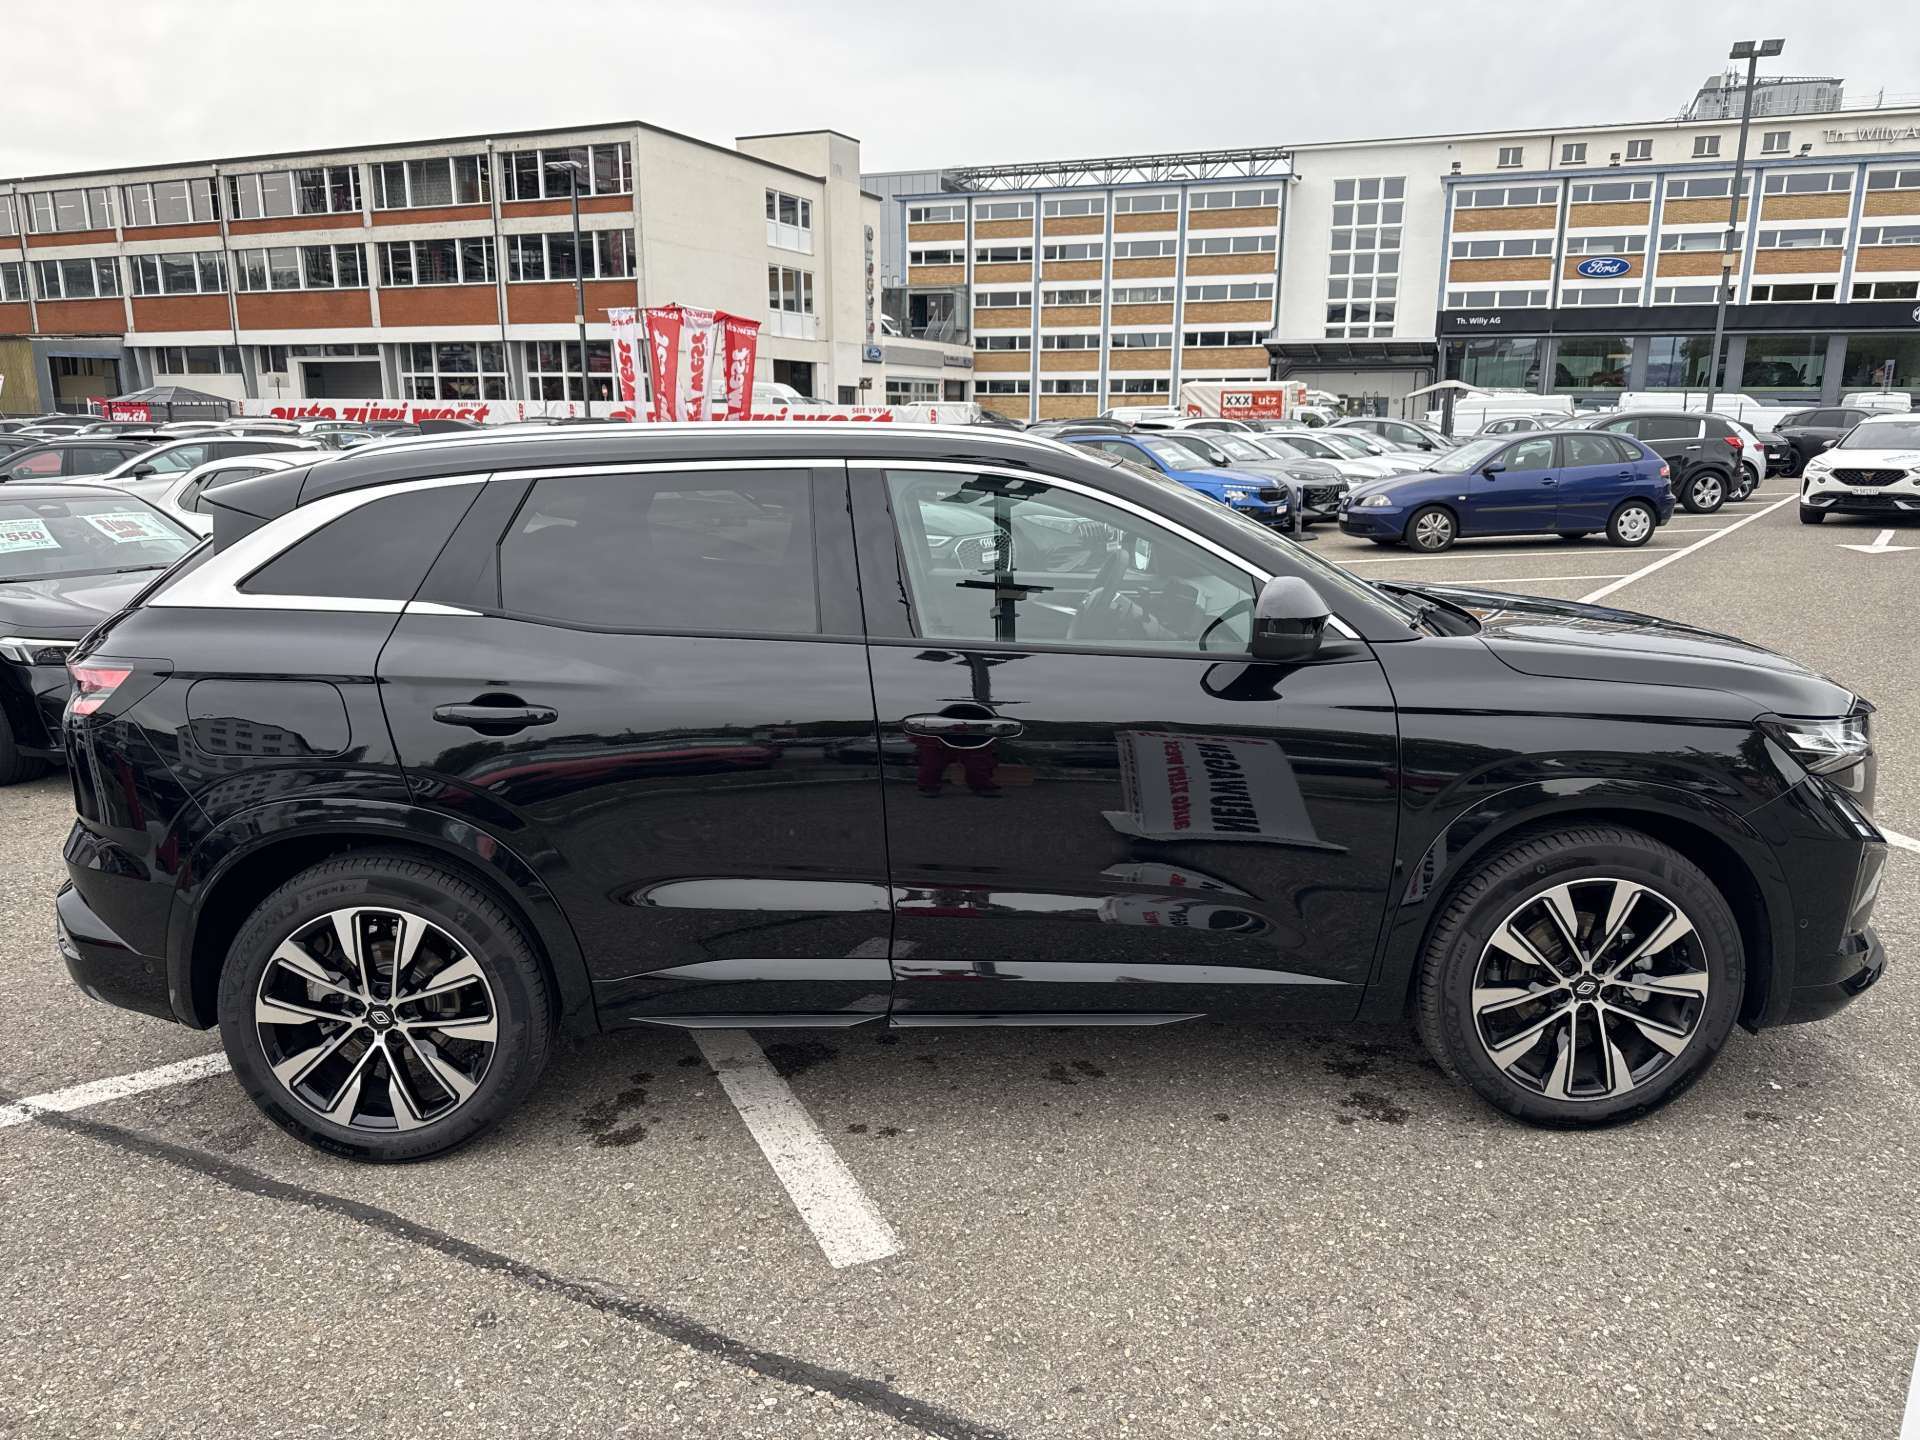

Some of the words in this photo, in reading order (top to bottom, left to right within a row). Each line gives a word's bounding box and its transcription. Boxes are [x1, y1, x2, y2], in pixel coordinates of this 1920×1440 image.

[1857, 127, 1900, 143] Willy
[1587, 259, 1621, 273] Ford
[1456, 317, 1467, 325] Th.
[1469, 317, 1488, 326] Willy
[1489, 316, 1501, 324] AG
[270, 403, 337, 422] auto
[412, 403, 490, 424] west
